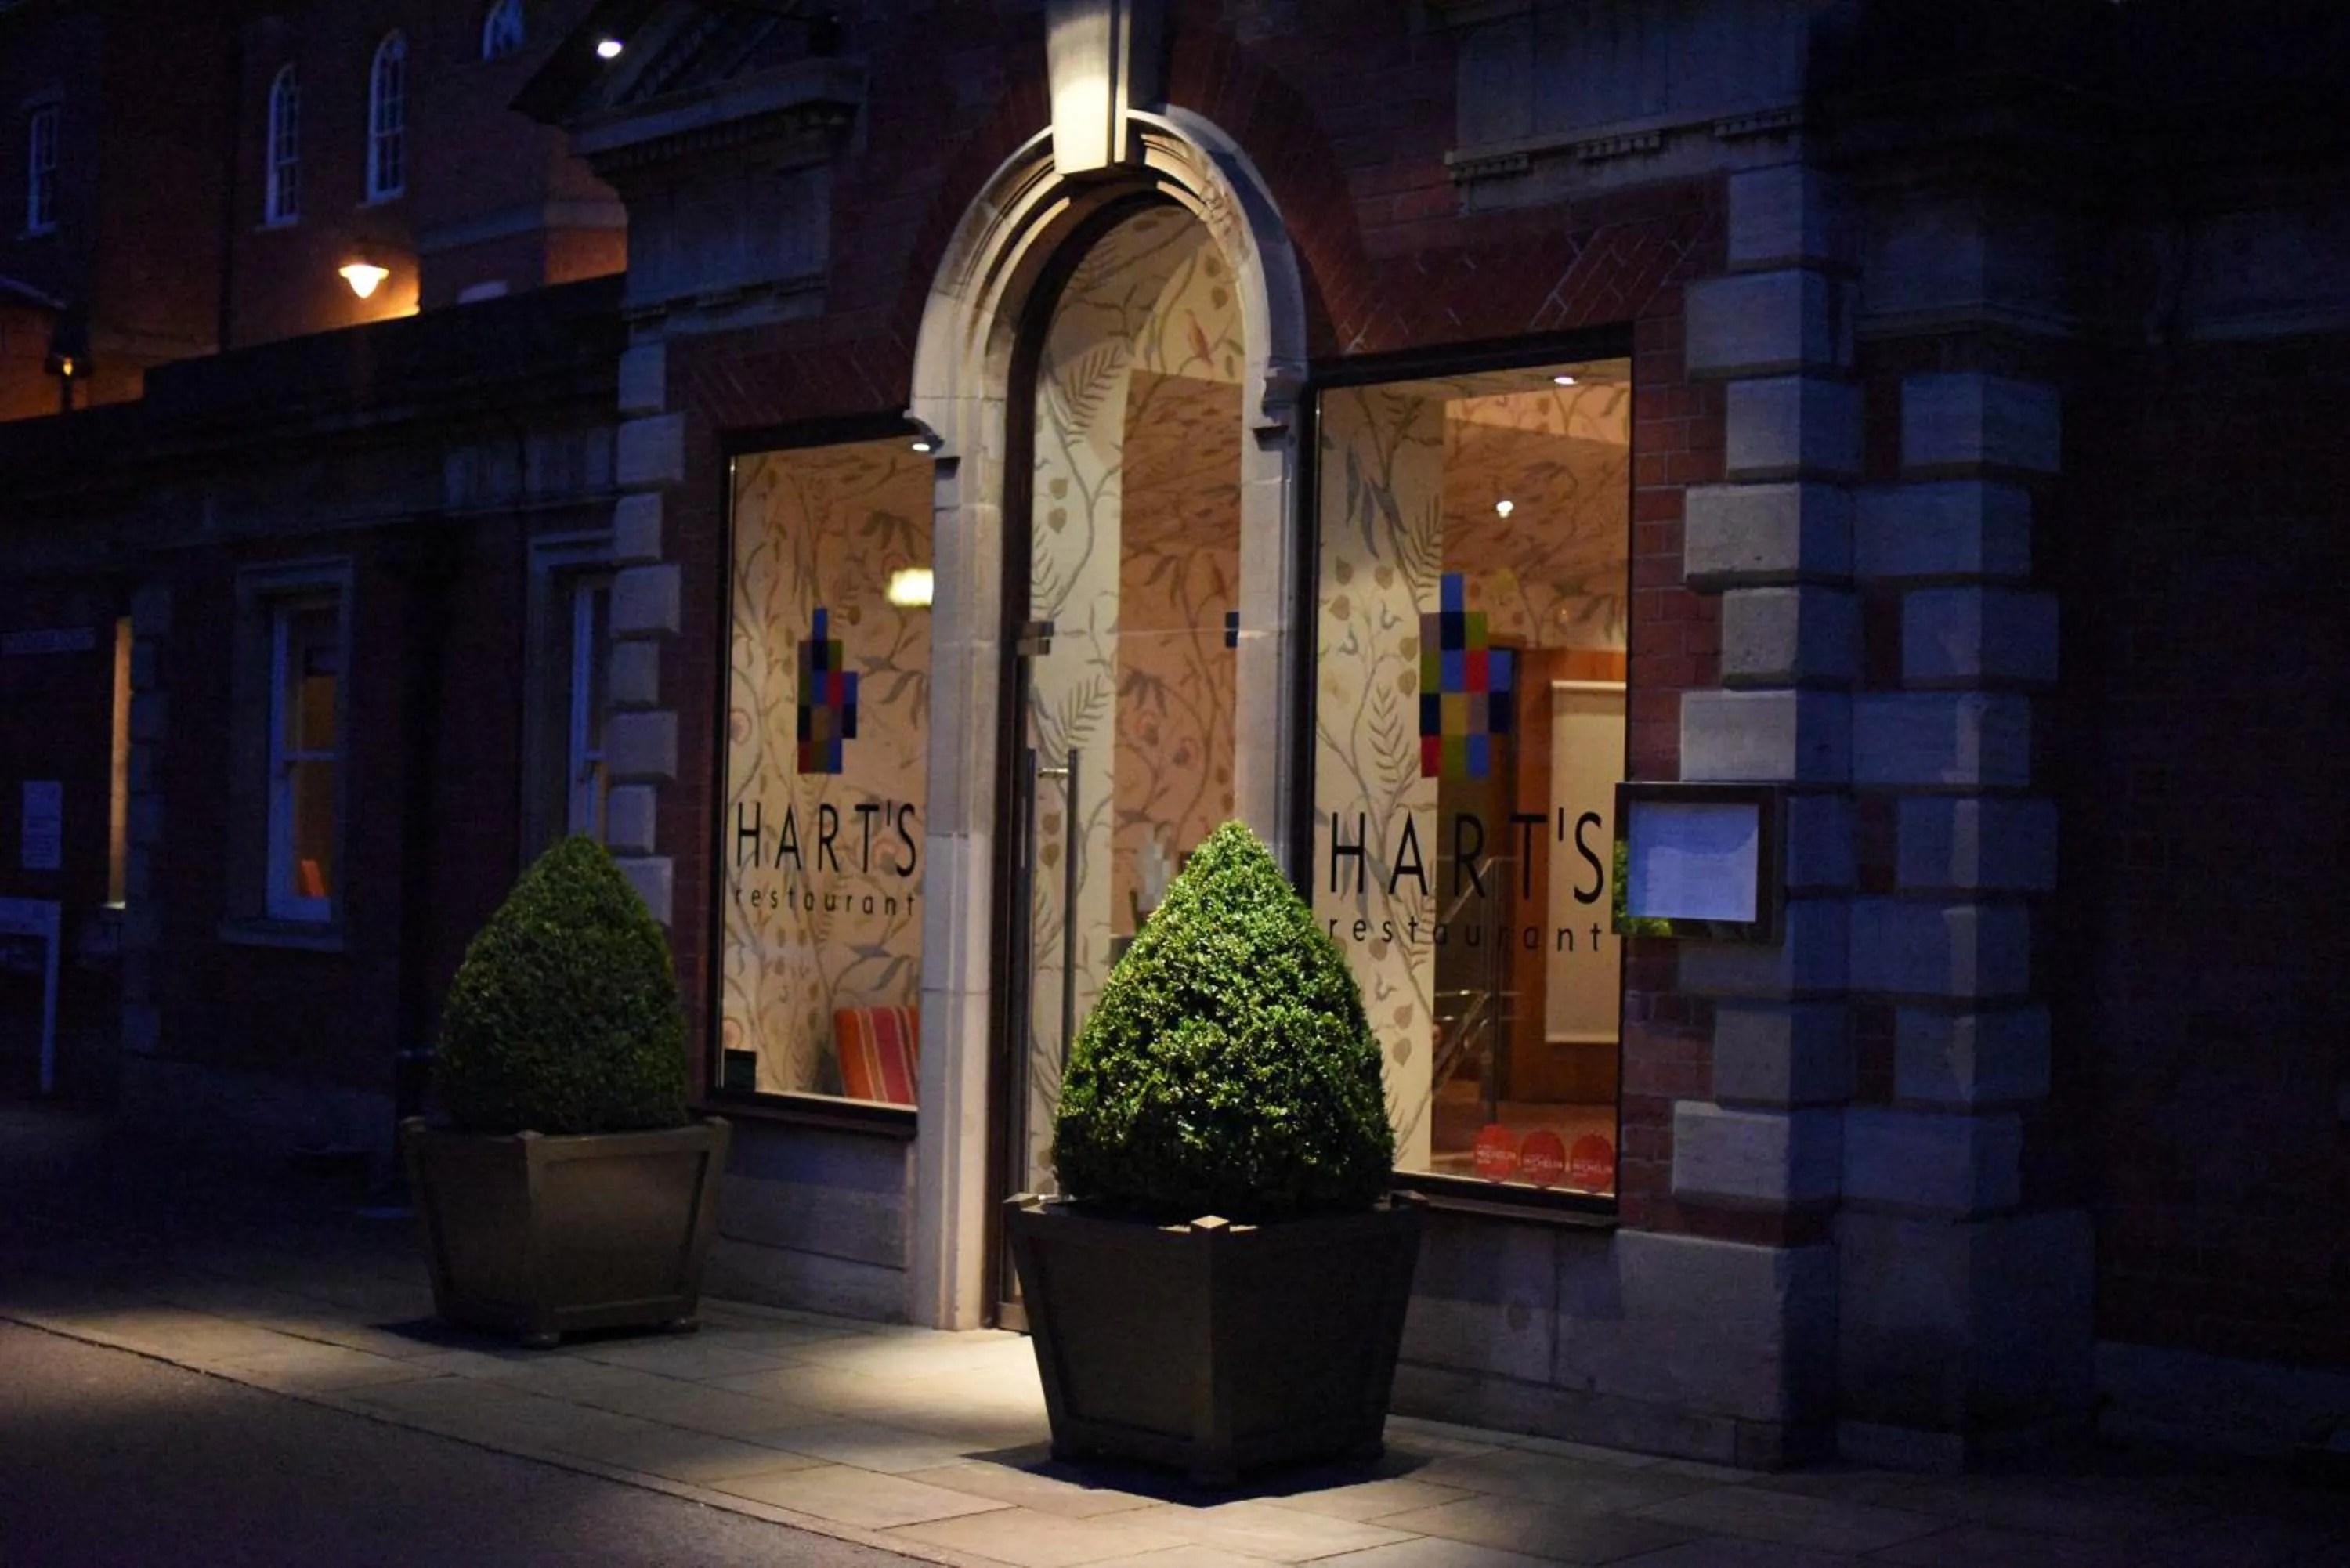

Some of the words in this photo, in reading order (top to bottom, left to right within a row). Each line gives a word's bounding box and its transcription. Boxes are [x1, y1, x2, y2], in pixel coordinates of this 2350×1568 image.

[736, 800, 916, 877] HART'S
[1330, 807, 1604, 905] HART'S
[735, 887, 915, 916] restaurant
[1329, 916, 1603, 952] restaurant
